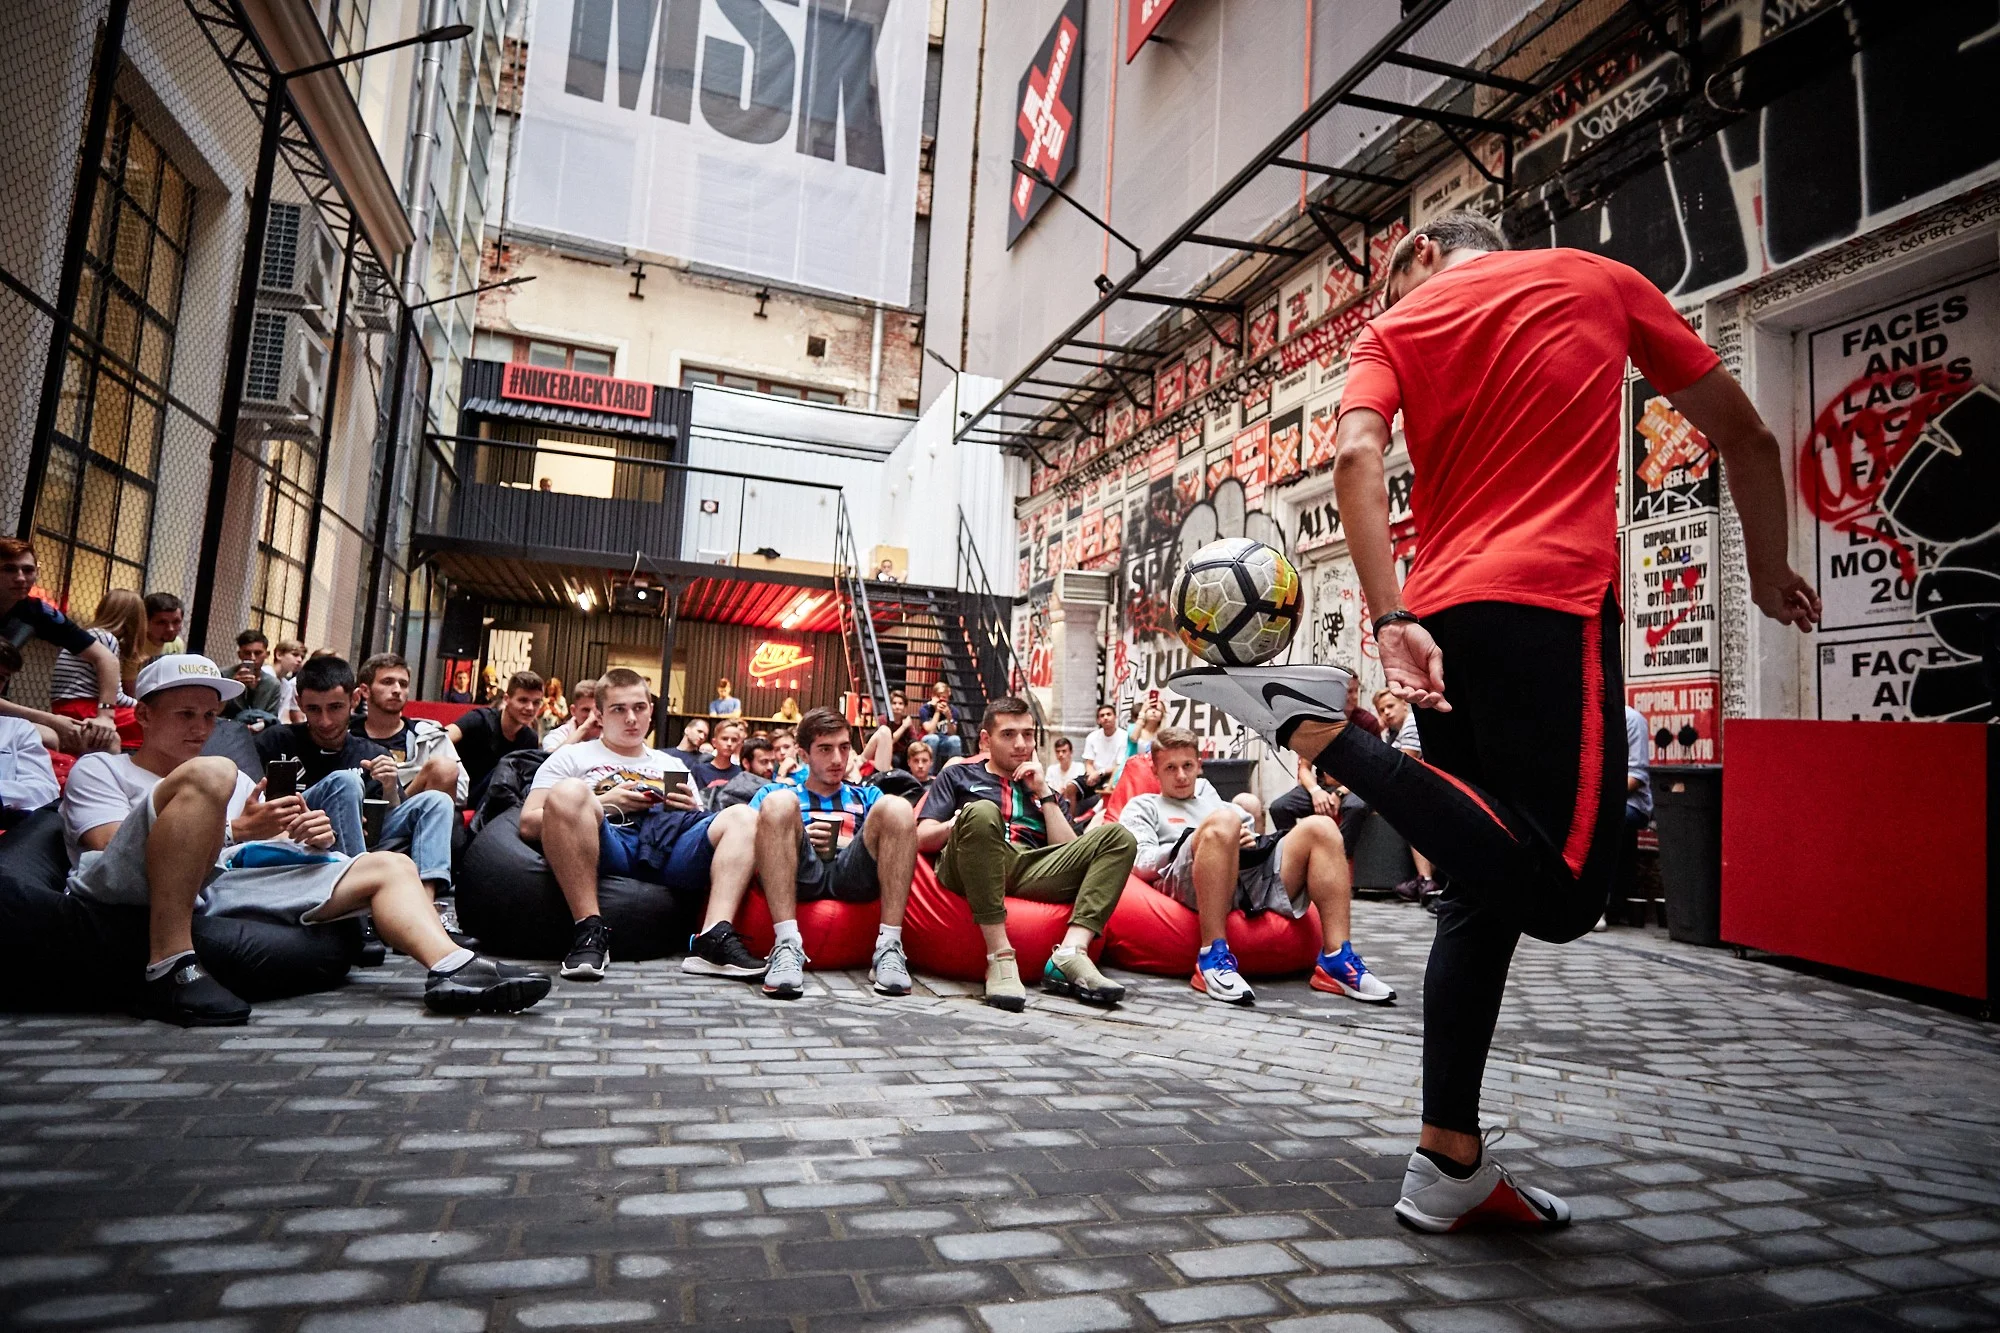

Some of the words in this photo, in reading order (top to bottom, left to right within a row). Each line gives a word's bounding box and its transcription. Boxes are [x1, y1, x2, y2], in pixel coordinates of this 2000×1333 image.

[564, 0, 886, 175] MSK
[1842, 296, 1969, 357] FACES
[1864, 333, 1949, 379] AND
[509, 367, 648, 412] #NIKEBACKYARD
[1843, 357, 1973, 415] LACES
[1689, 521, 1707, 539] ТЕБЕ
[1644, 572, 1659, 587] ЧТО
[1662, 563, 1708, 586] УЛИЧМУ
[1870, 574, 1915, 604] 20
[1637, 610, 1674, 628] НИКОГДА
[487, 629, 534, 661] NIKE
[1650, 627, 1703, 647] СТОЯЩИМ
[757, 643, 802, 664] NIKE
[1644, 647, 1708, 667] ФУТБОЛИСТОМ
[1852, 647, 1953, 677] FACE
